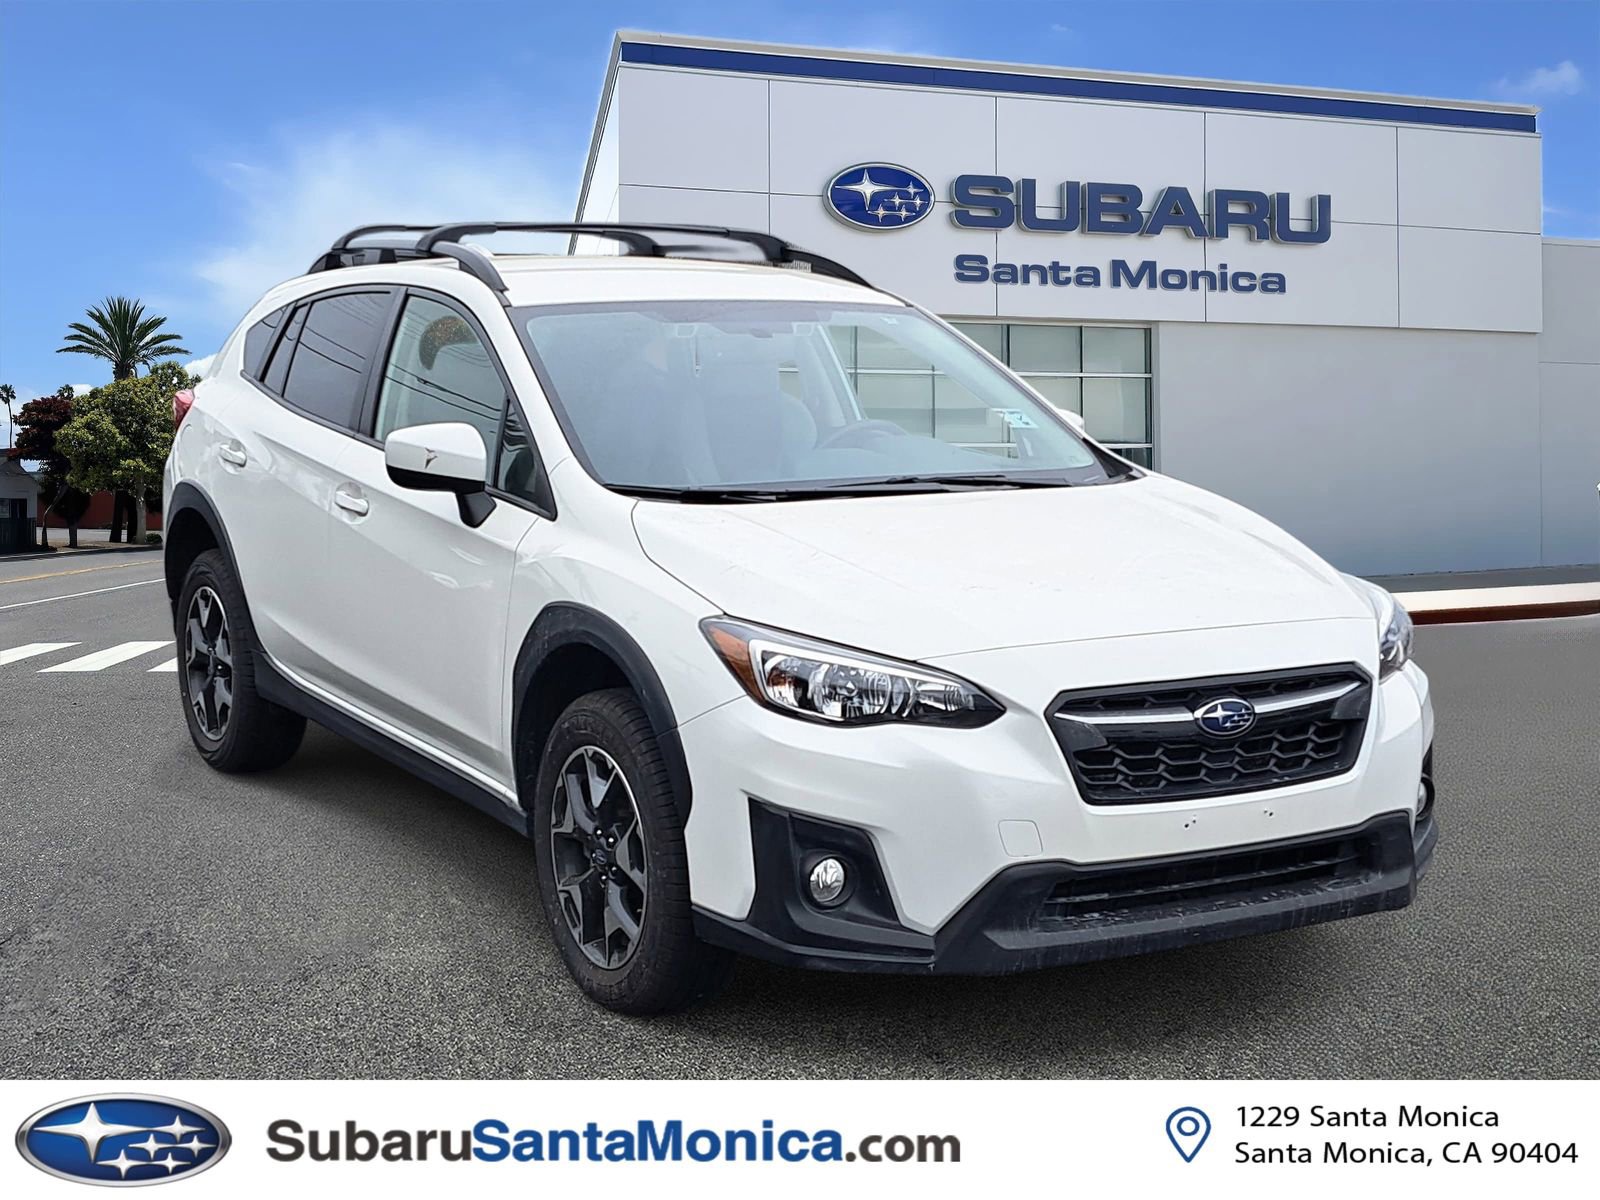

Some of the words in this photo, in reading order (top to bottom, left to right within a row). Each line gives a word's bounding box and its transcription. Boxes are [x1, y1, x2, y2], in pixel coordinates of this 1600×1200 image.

[951, 174, 1332, 244] SUBARU
[955, 254, 1101, 287] Santa
[1111, 259, 1287, 294] Monica
